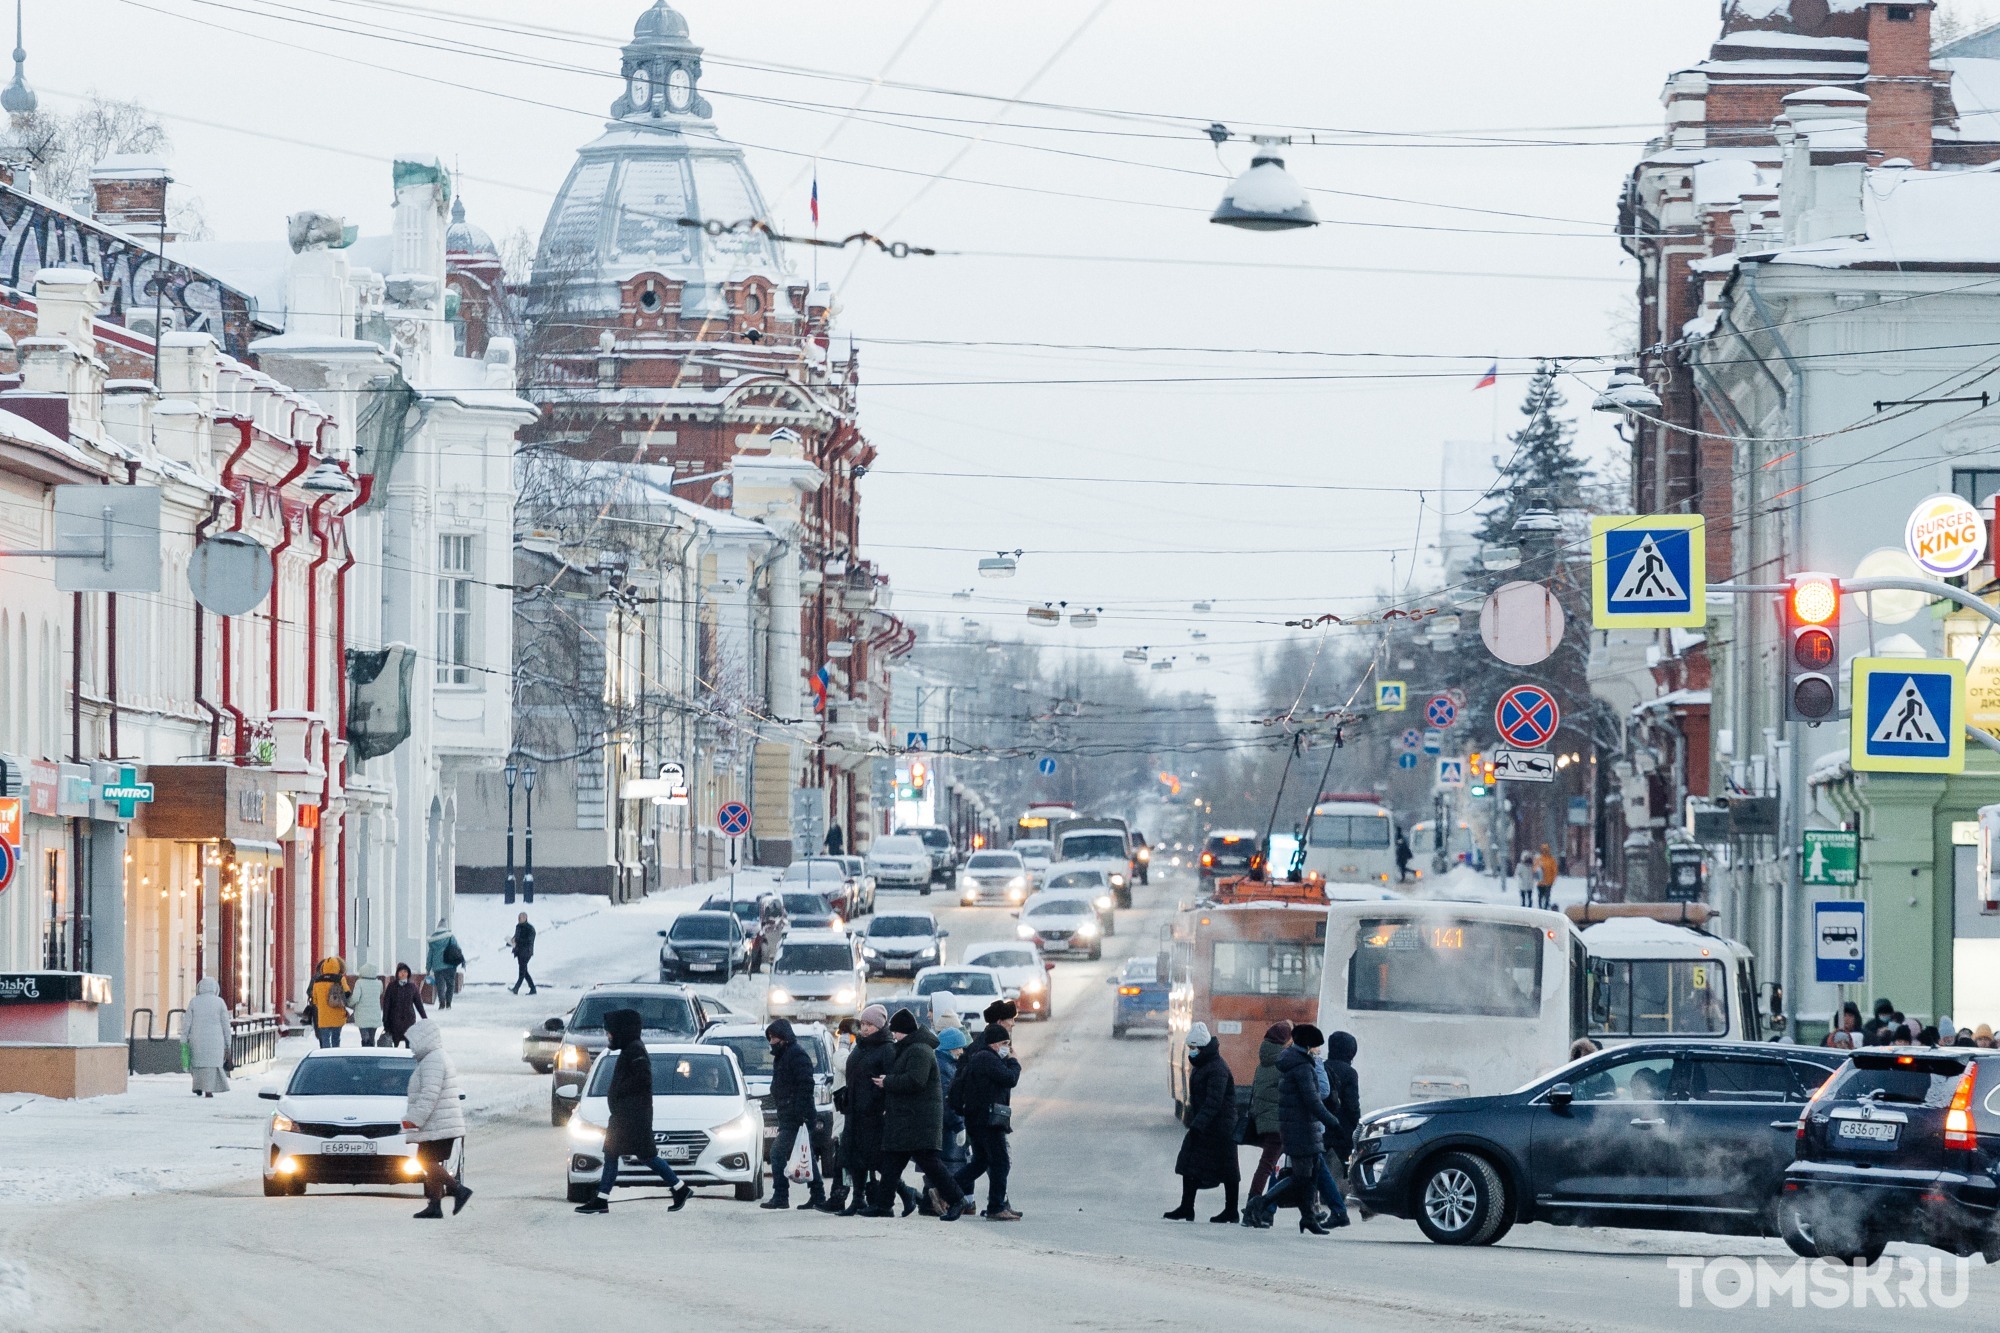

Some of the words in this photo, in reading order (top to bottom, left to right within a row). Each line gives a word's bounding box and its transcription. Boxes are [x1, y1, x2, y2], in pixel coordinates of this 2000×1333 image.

[1916, 511, 1974, 539] BURGER
[1919, 524, 1976, 558] KING
[1813, 637, 1831, 661] 16
[104, 787, 150, 799] INVITRO
[1434, 927, 1463, 948] 141
[1695, 969, 1704, 986] 5
[1883, 1124, 1893, 1134] 70
[363, 1142, 374, 1150] 70
[676, 1147, 685, 1155] 70
